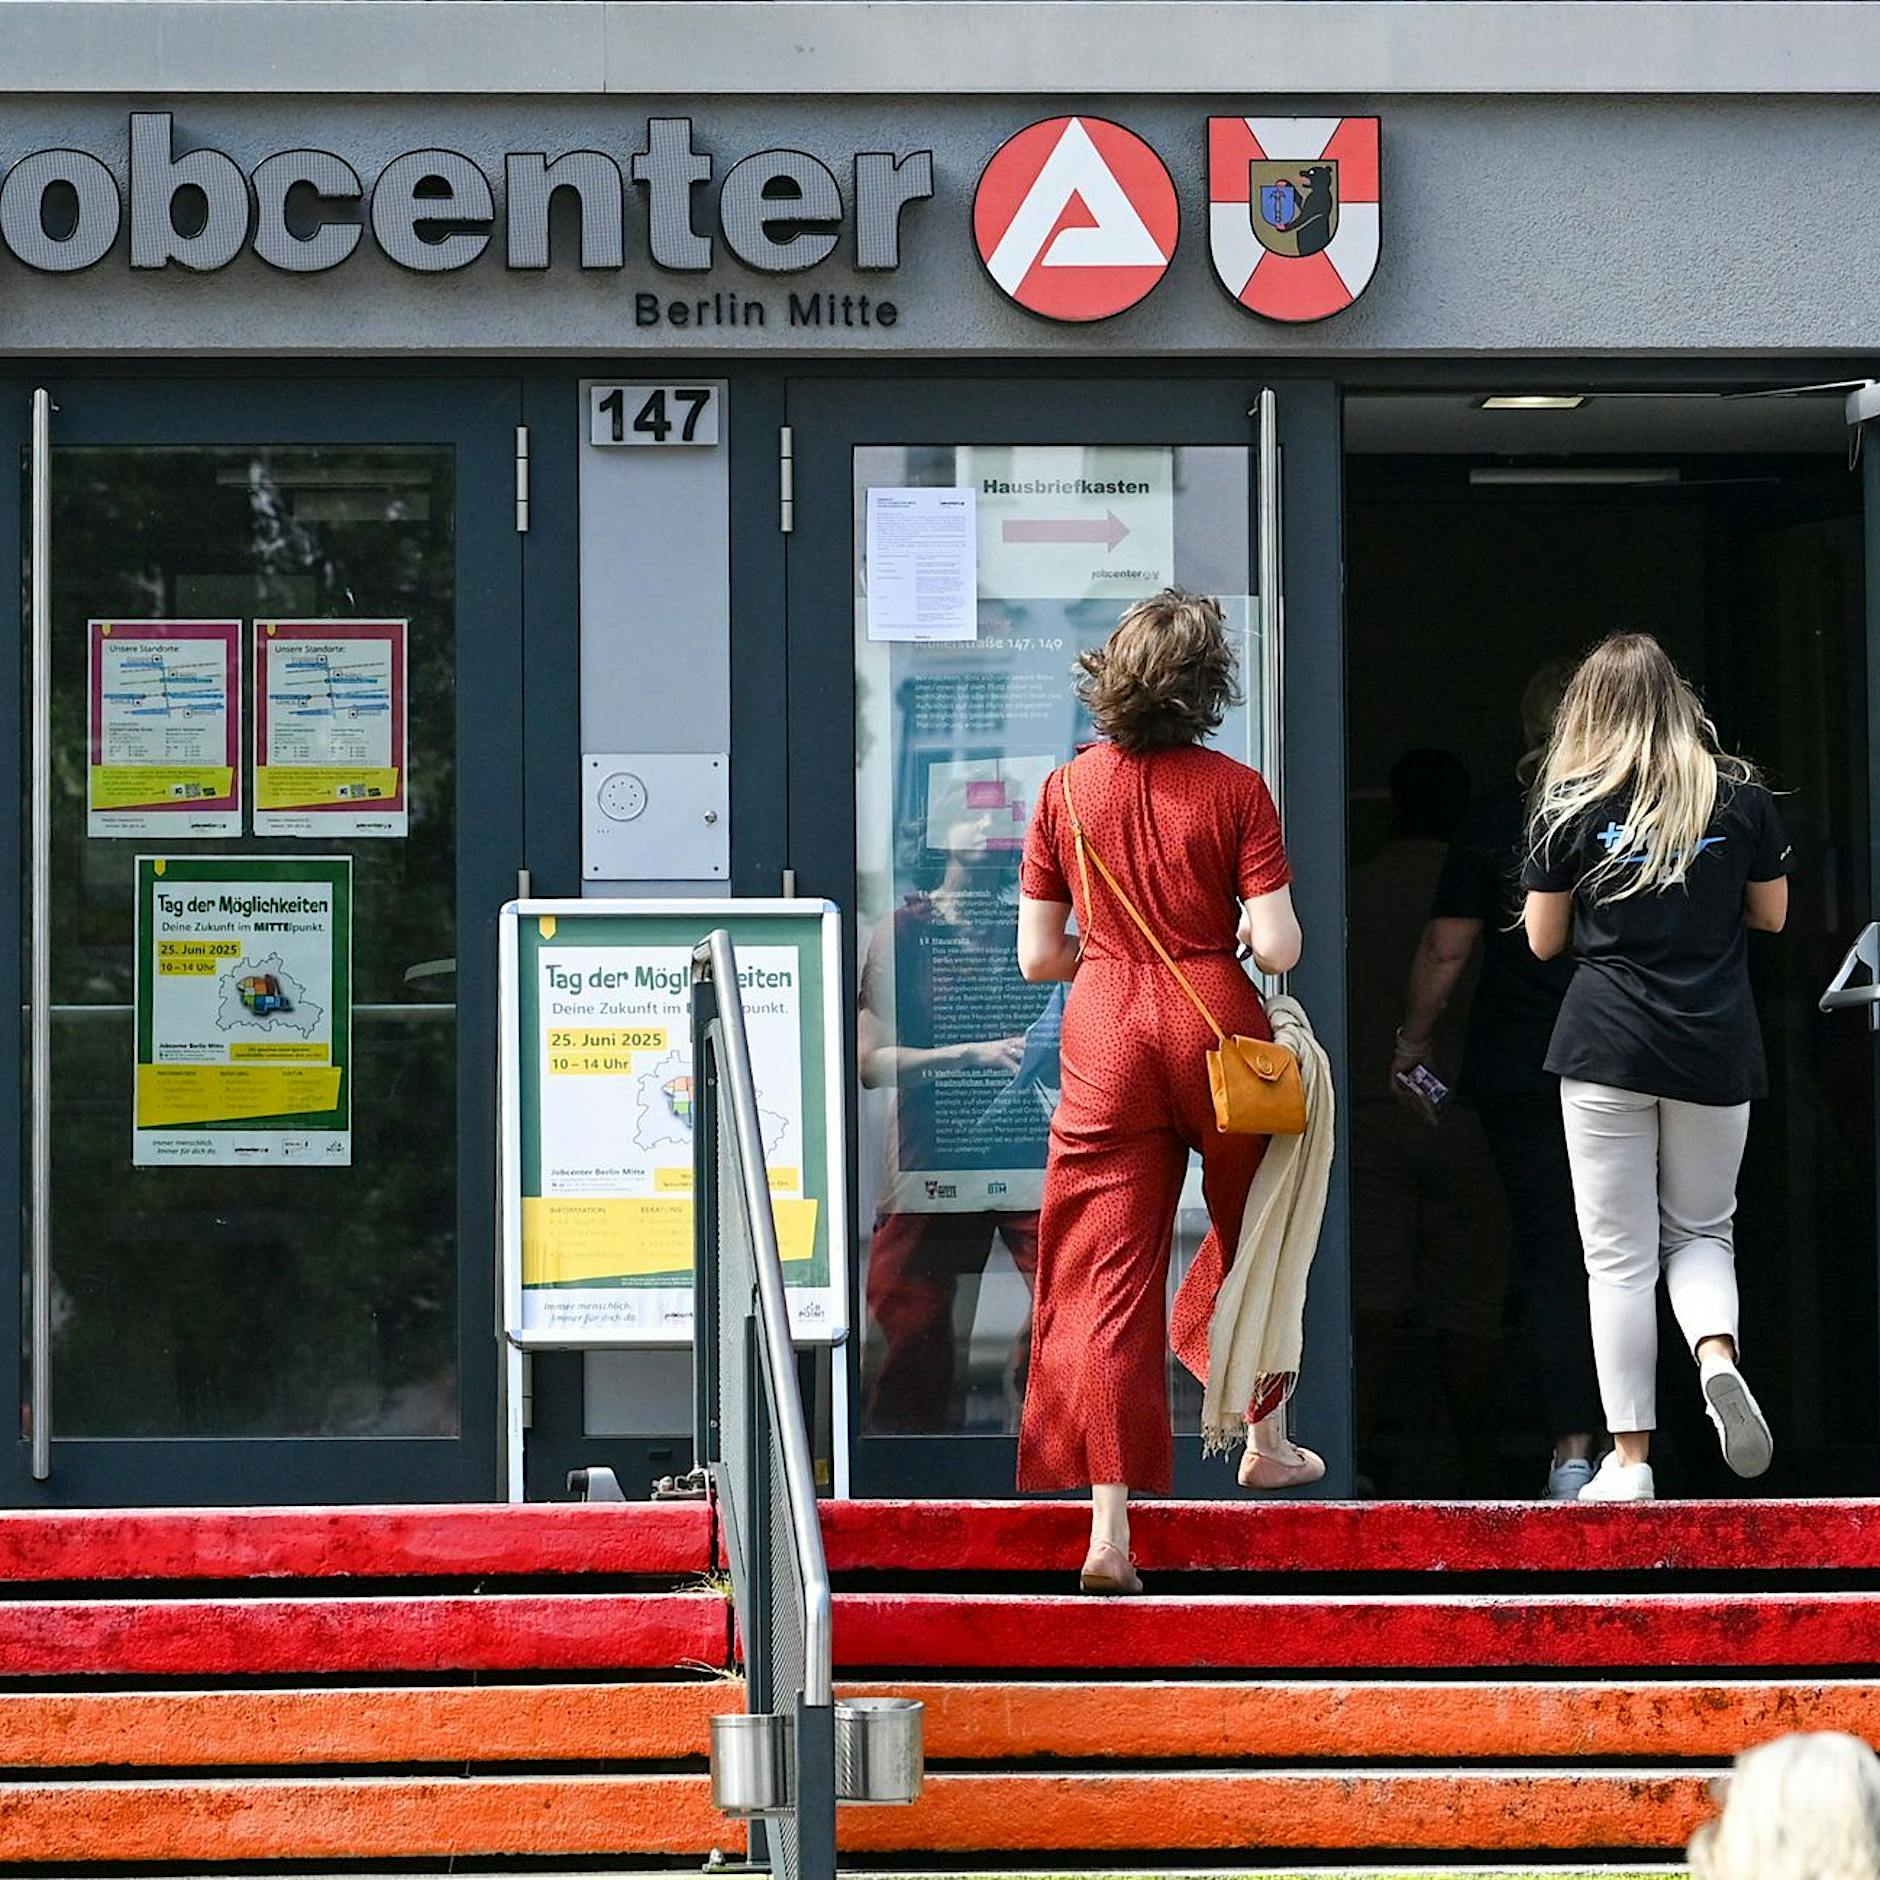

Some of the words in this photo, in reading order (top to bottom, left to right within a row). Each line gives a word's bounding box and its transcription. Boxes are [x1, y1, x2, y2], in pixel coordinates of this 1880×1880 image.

[635, 293, 765, 327] Berlin
[788, 293, 898, 327] Mitte
[598, 389, 711, 442] 147
[982, 479, 1150, 494] Hausbriefkasten
[109, 644, 138, 653] Unsere
[274, 644, 303, 653] Unsere
[158, 894, 183, 917] Tag
[187, 896, 215, 913] der
[219, 896, 328, 917] Möglichkeiten
[162, 922, 191, 932] Deine
[194, 922, 235, 932] Zukunft
[238, 922, 250, 932] im
[161, 945, 178, 956] 25.
[181, 945, 206, 956] Juni
[209, 945, 237, 956] 2025
[196, 963, 215, 972] Uhr
[545, 965, 582, 995] Tag
[588, 966, 629, 988] der
[635, 965, 792, 995] Mögleiten
[553, 1003, 595, 1015] Deine
[600, 1002, 658, 1015] Zukunft
[663, 1003, 681, 1014] im
[551, 1034, 576, 1047] 25.
[582, 1034, 616, 1047] Juni
[622, 1034, 662, 1047] 2025
[553, 1058, 568, 1069] 10
[584, 1058, 599, 1069] 14
[603, 1058, 629, 1069] Uhr
[551, 1168, 593, 1177] Jobcenter
[595, 1168, 620, 1177] Berlin
[622, 1168, 645, 1177] Mitte
